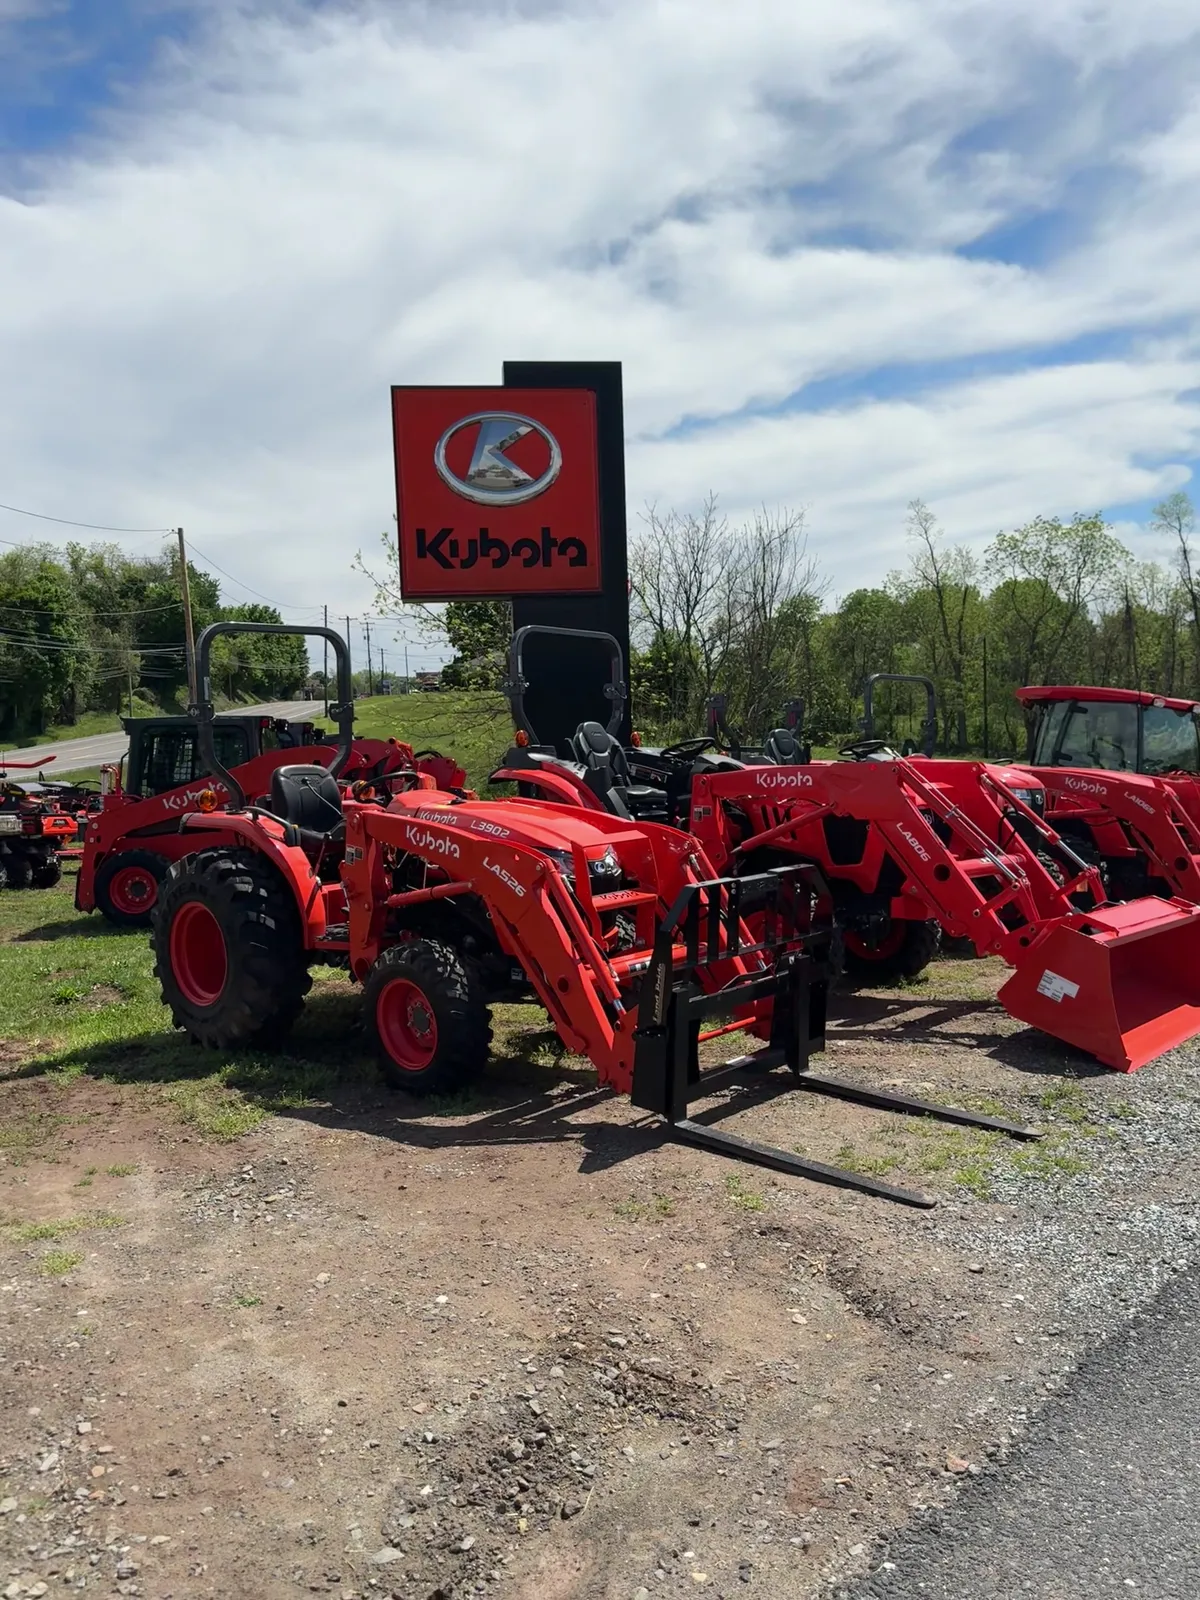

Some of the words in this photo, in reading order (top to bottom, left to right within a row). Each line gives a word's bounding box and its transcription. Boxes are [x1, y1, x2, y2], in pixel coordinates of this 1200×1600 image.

[415, 527, 588, 569] Kubota
[162, 781, 229, 810] Kubta
[756, 772, 813, 788] Kubota
[1065, 777, 1107, 795] Kubota
[406, 825, 460, 859] Kubota
[470, 820, 510, 839] L3902
[896, 822, 931, 862] LA806
[482, 856, 527, 897] LA526
